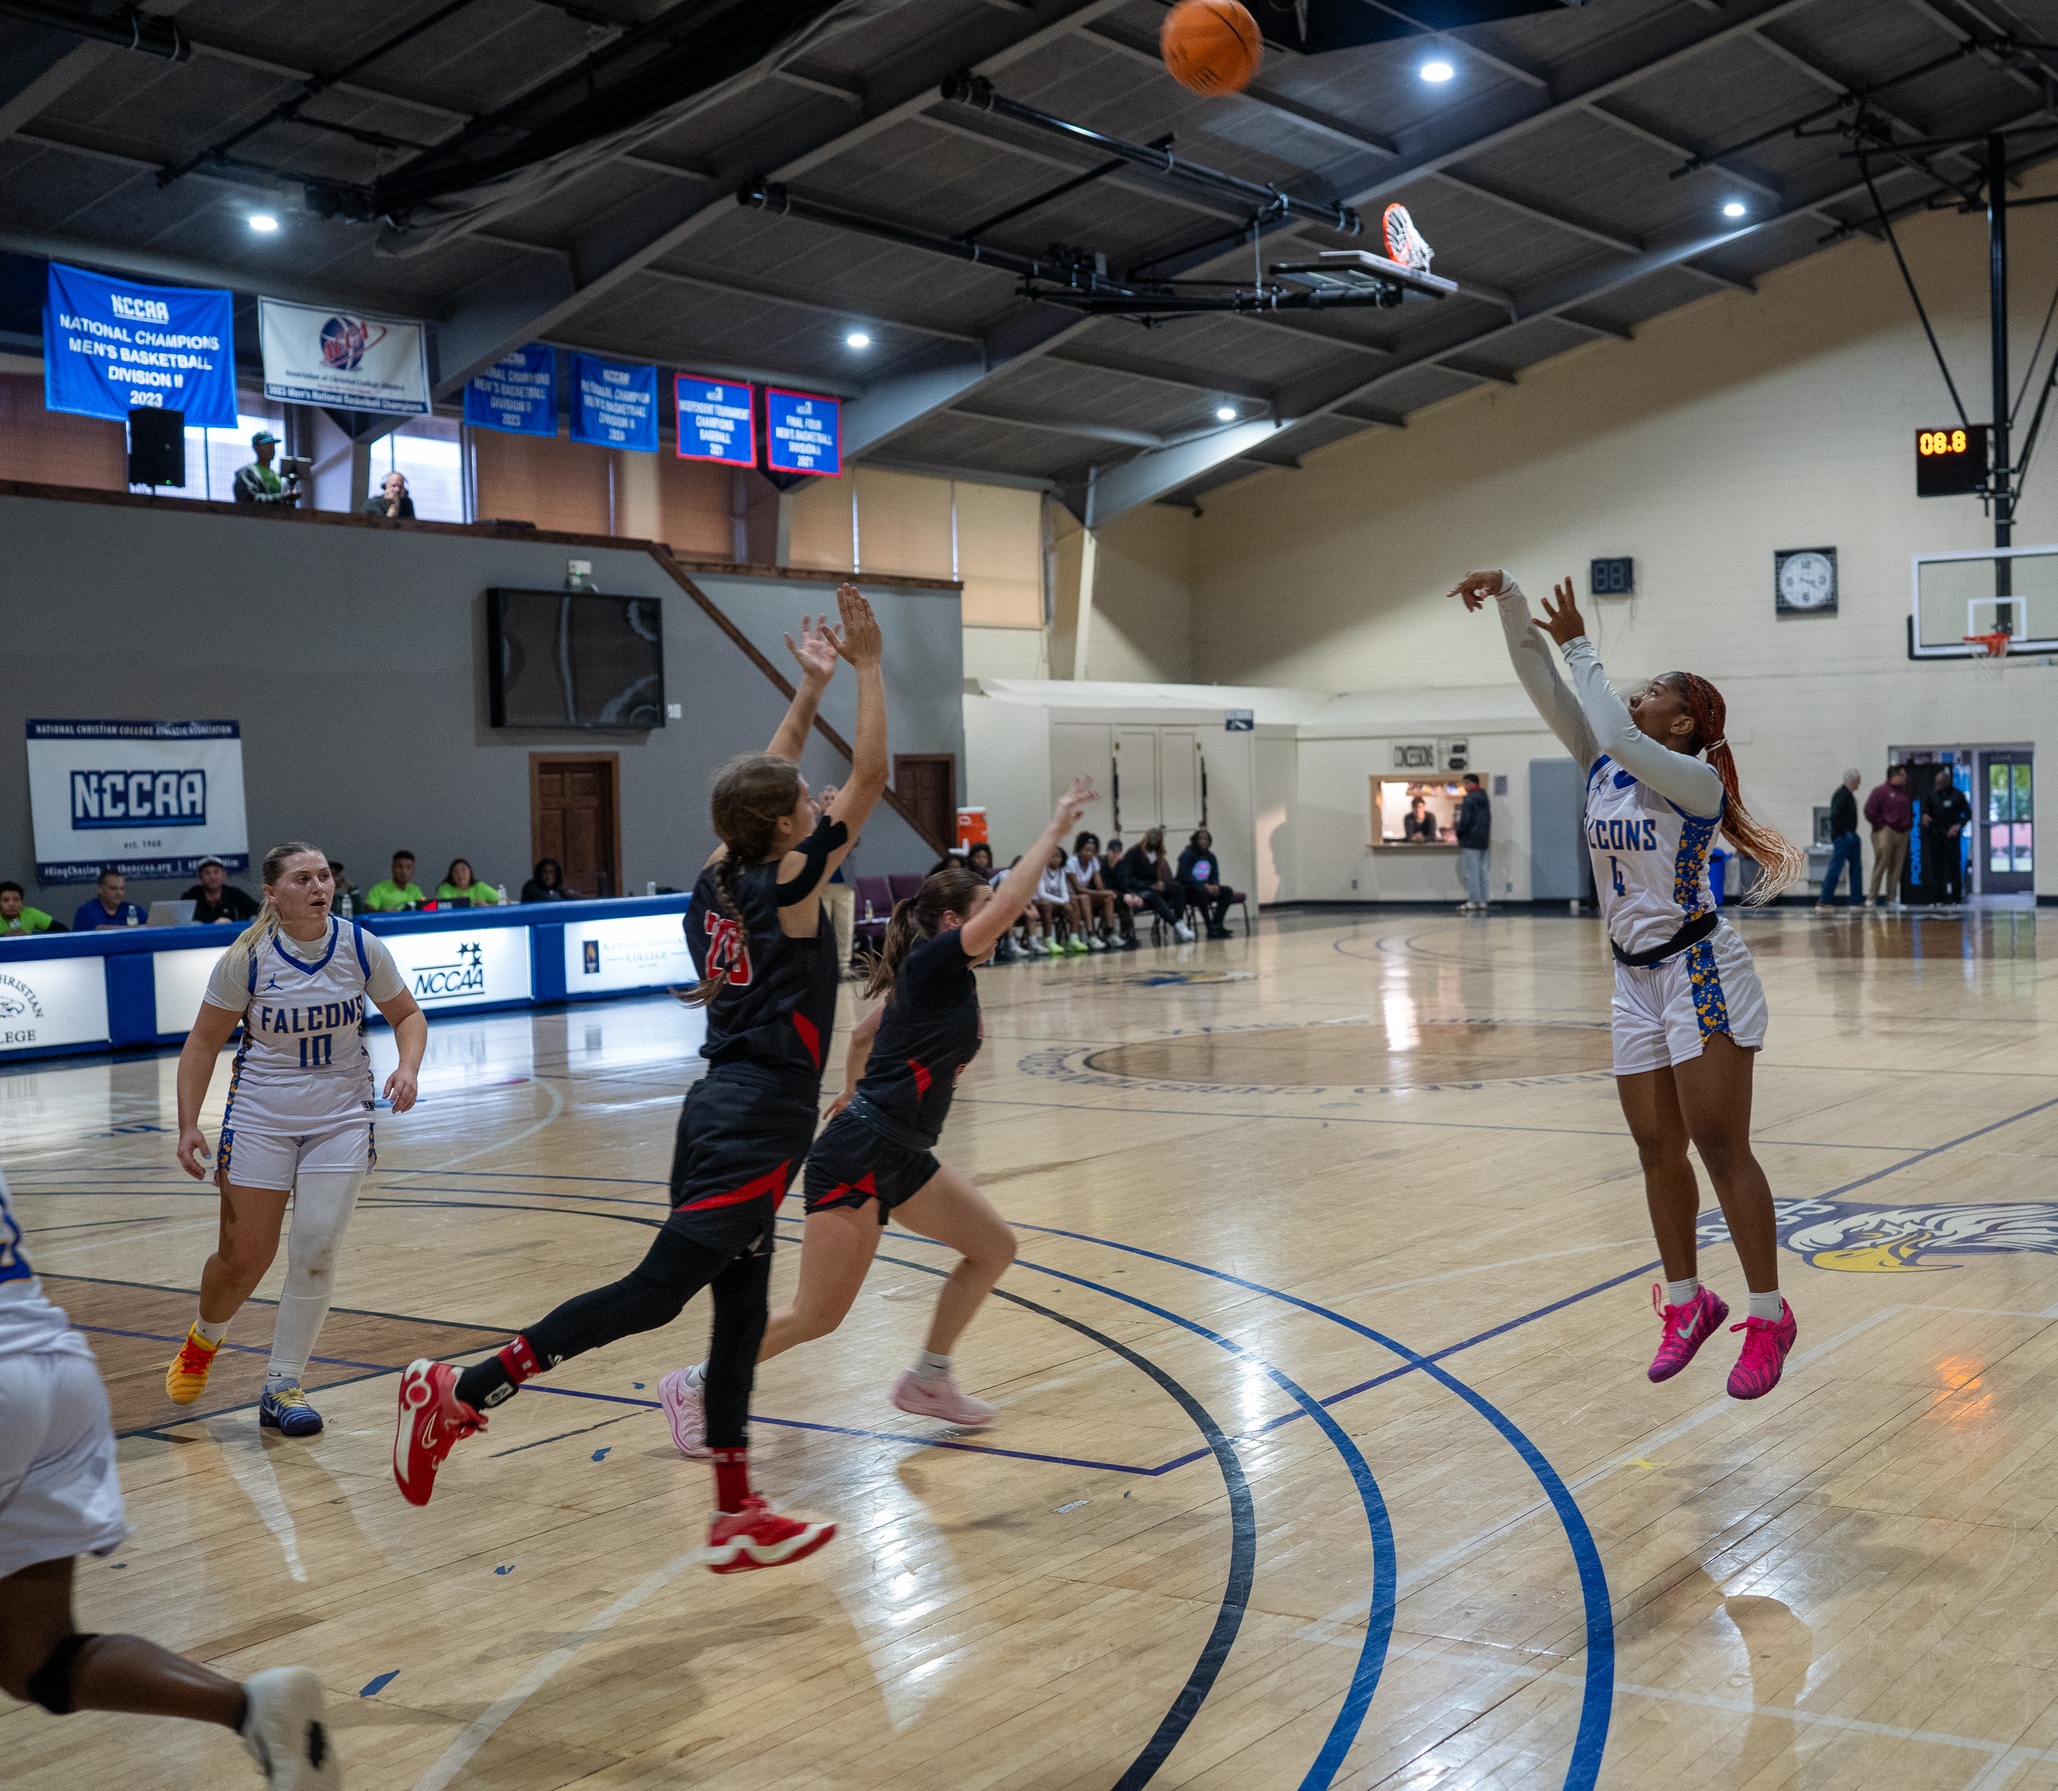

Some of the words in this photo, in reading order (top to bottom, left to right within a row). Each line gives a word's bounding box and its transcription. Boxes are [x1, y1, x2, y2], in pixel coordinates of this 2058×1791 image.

[111, 294, 170, 324] NCCAA
[60, 313, 132, 343] NATIONAL
[135, 330, 220, 351] CHAMPIONS
[69, 337, 118, 359] MEN'S
[120, 347, 213, 371] BASKETBALL
[108, 366, 172, 388] DIVISION
[174, 373, 184, 388] II
[129, 390, 163, 408] 2023
[312, 390, 343, 403] National
[1920, 430, 1966, 456] 08.8
[36, 724, 75, 735] NATIONAL
[76, 725, 117, 735] CHRISTIAN
[119, 726, 154, 736] COLLEGE
[71, 770, 206, 829] NCCAA
[1588, 818, 1657, 851] LCONS
[1606, 855, 1626, 897] 4
[0, 975, 44, 1018] HRISTIAN
[414, 968, 484, 995] NCCAA
[261, 994, 363, 1034] FALCONS
[298, 1033, 333, 1068] 10
